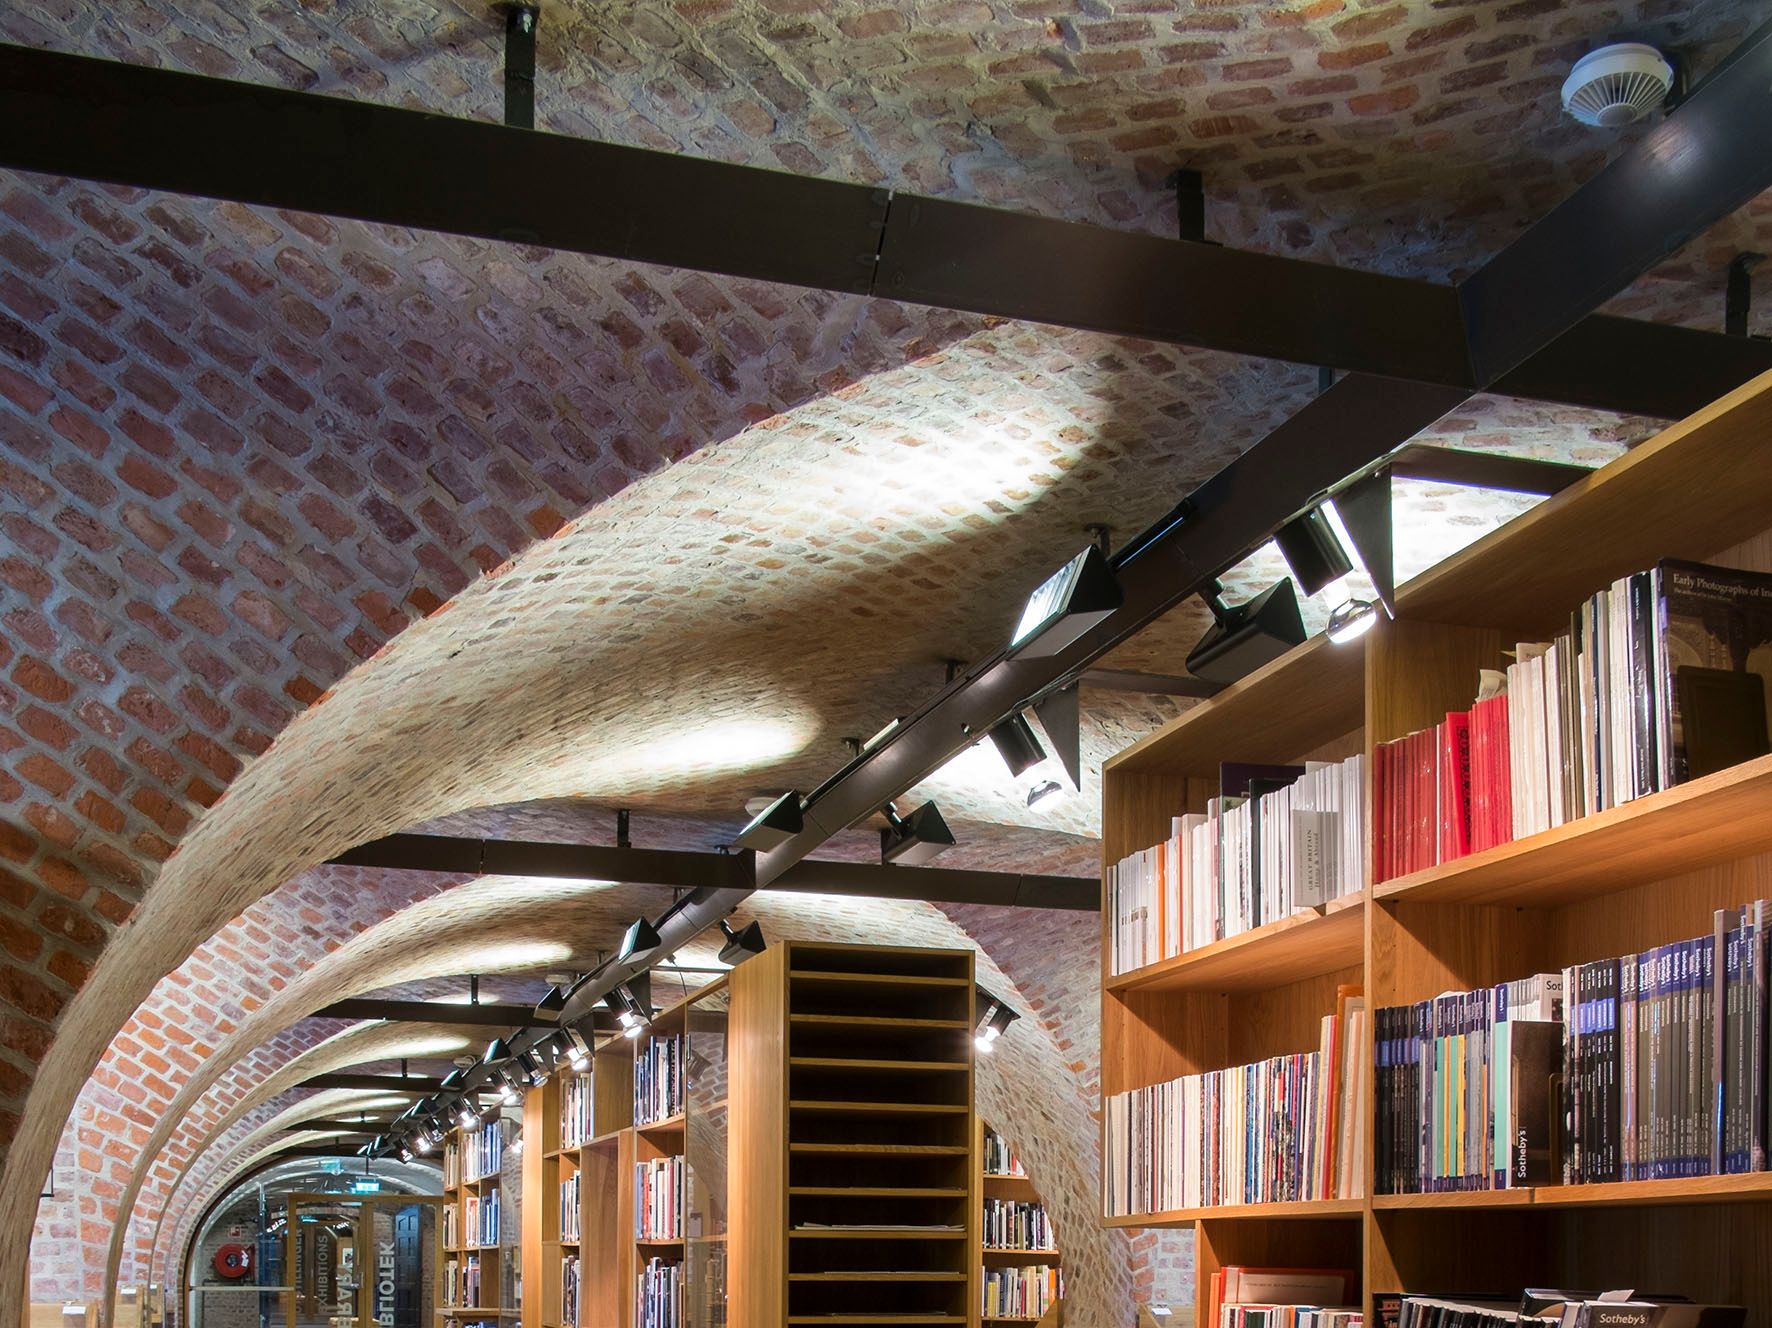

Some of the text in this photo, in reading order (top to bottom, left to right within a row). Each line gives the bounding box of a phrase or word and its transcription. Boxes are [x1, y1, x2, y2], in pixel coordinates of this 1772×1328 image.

[1673, 573, 1695, 588] Early
[1696, 577, 1749, 597] Photographs
[1749, 586, 1759, 597] of
[1518, 1129, 1527, 1178] Sotheby's
[318, 1235, 328, 1314] EXHIBITIONS
[1599, 1313, 1646, 1326] Sotheby's
